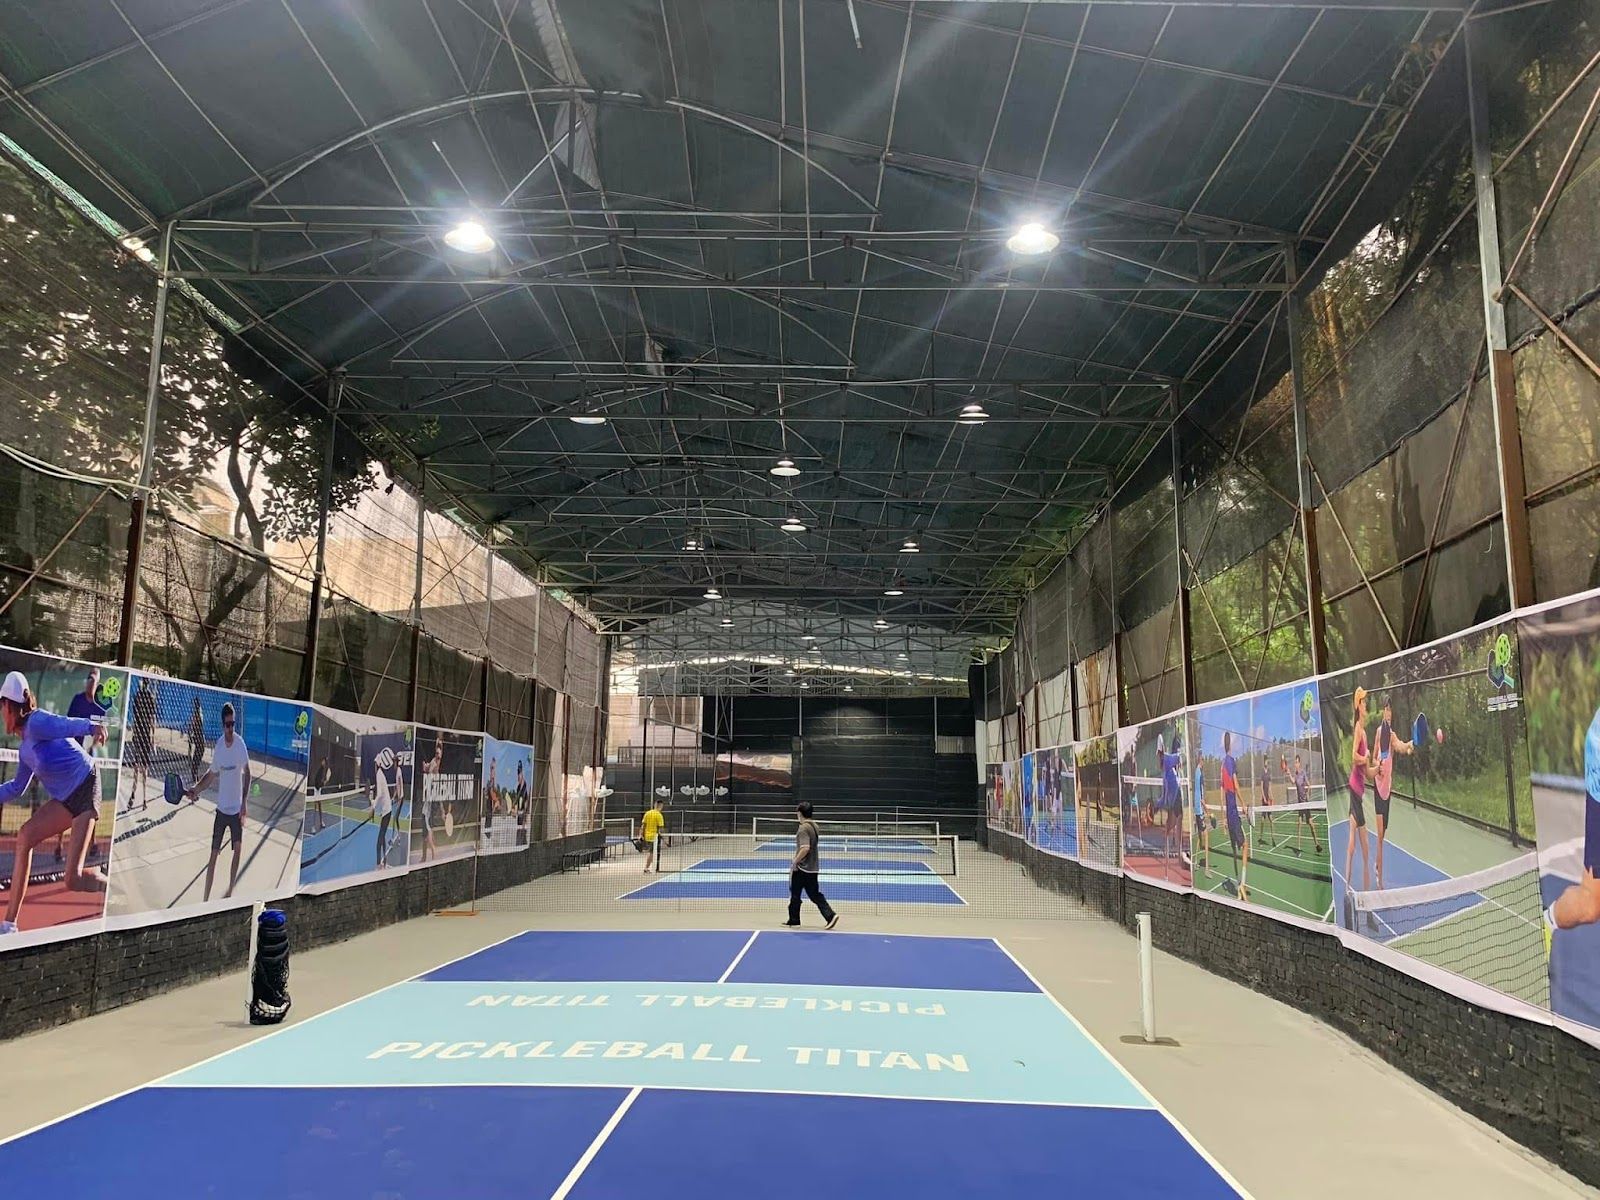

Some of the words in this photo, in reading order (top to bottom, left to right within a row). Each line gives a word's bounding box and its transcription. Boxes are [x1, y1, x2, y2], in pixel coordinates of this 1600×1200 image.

[465, 994, 611, 1007] TITAN
[636, 994, 947, 1016] PICKLEBALL
[366, 1040, 762, 1063] PICKLEBALL
[787, 1046, 970, 1073] TITAN
